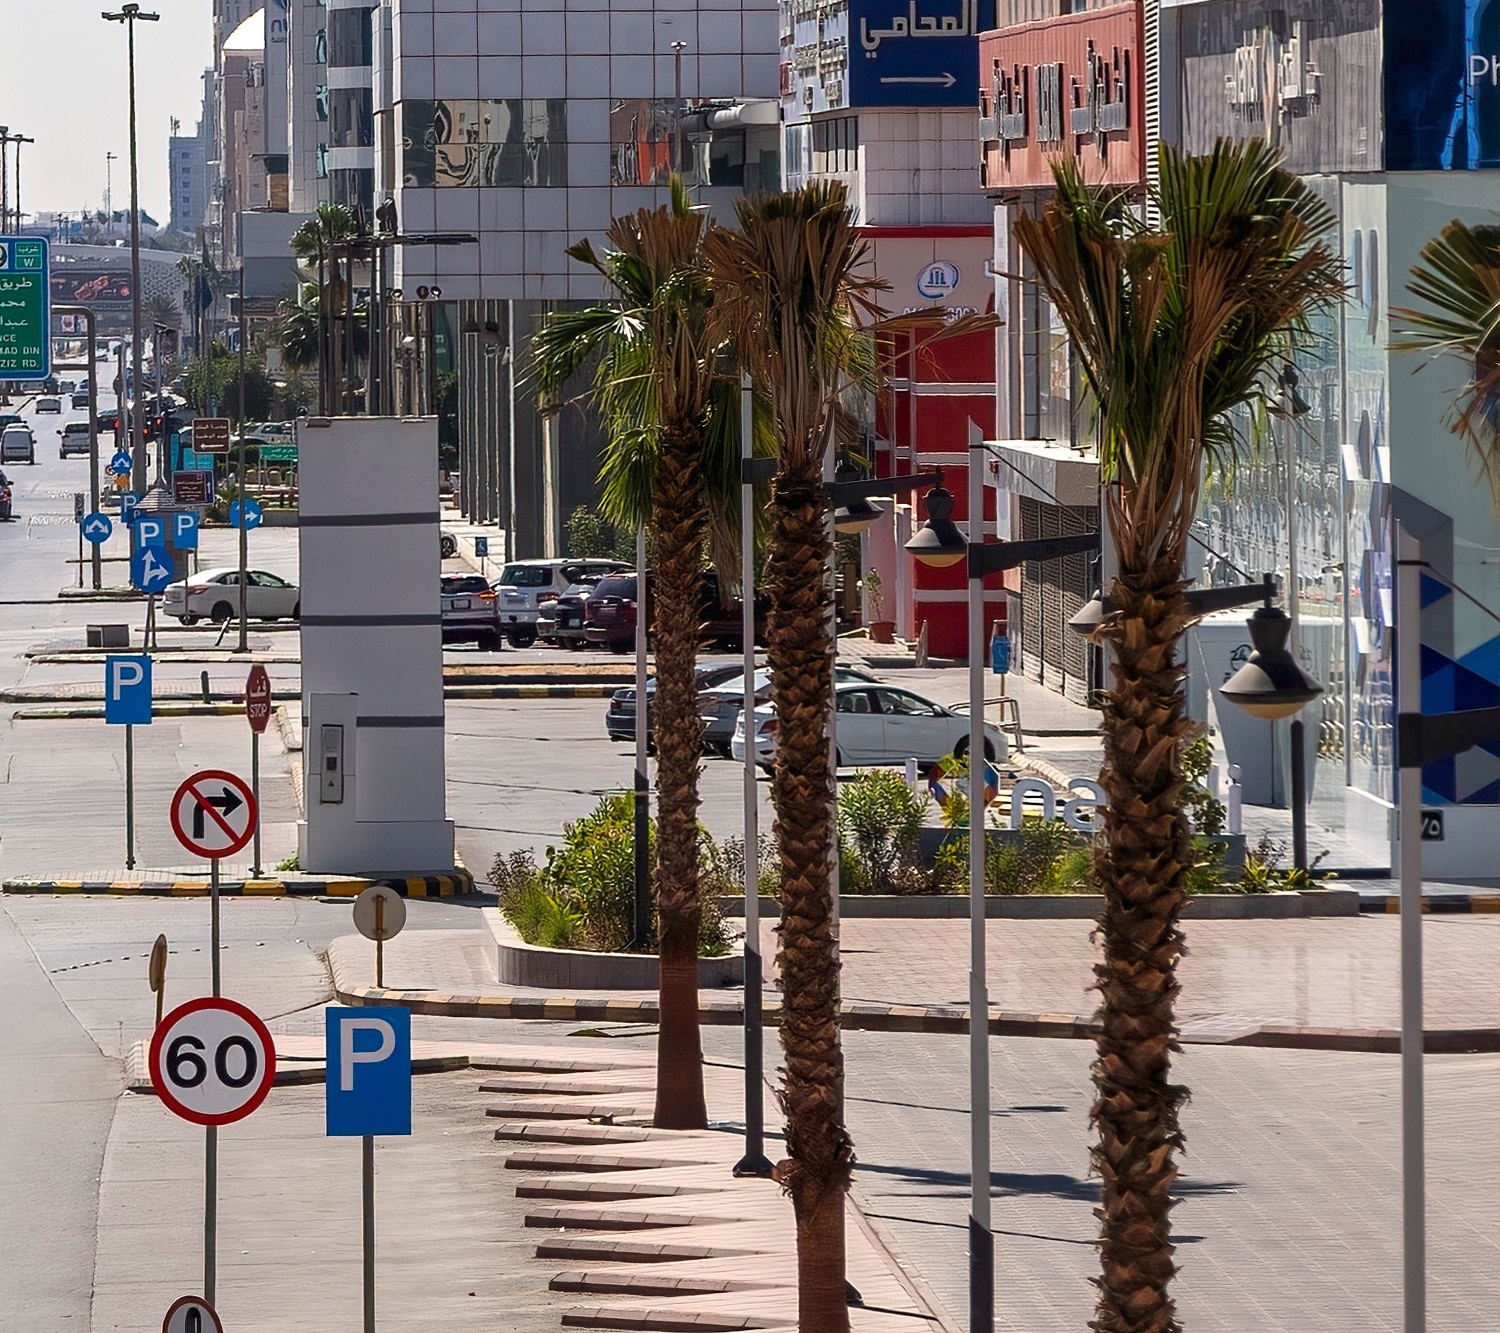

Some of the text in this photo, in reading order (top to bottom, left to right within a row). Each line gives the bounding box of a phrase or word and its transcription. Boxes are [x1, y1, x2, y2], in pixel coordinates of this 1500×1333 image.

[860, 0, 978, 59] المحامي
[23, 258, 34, 267] W
[23, 346, 40, 355] BIN
[123, 495, 137, 513] P
[140, 522, 160, 547] P
[177, 515, 194, 536] P
[113, 661, 144, 701] P
[250, 703, 267, 718] STOP
[166, 1035, 258, 1089] 60
[340, 1018, 396, 1091] P
